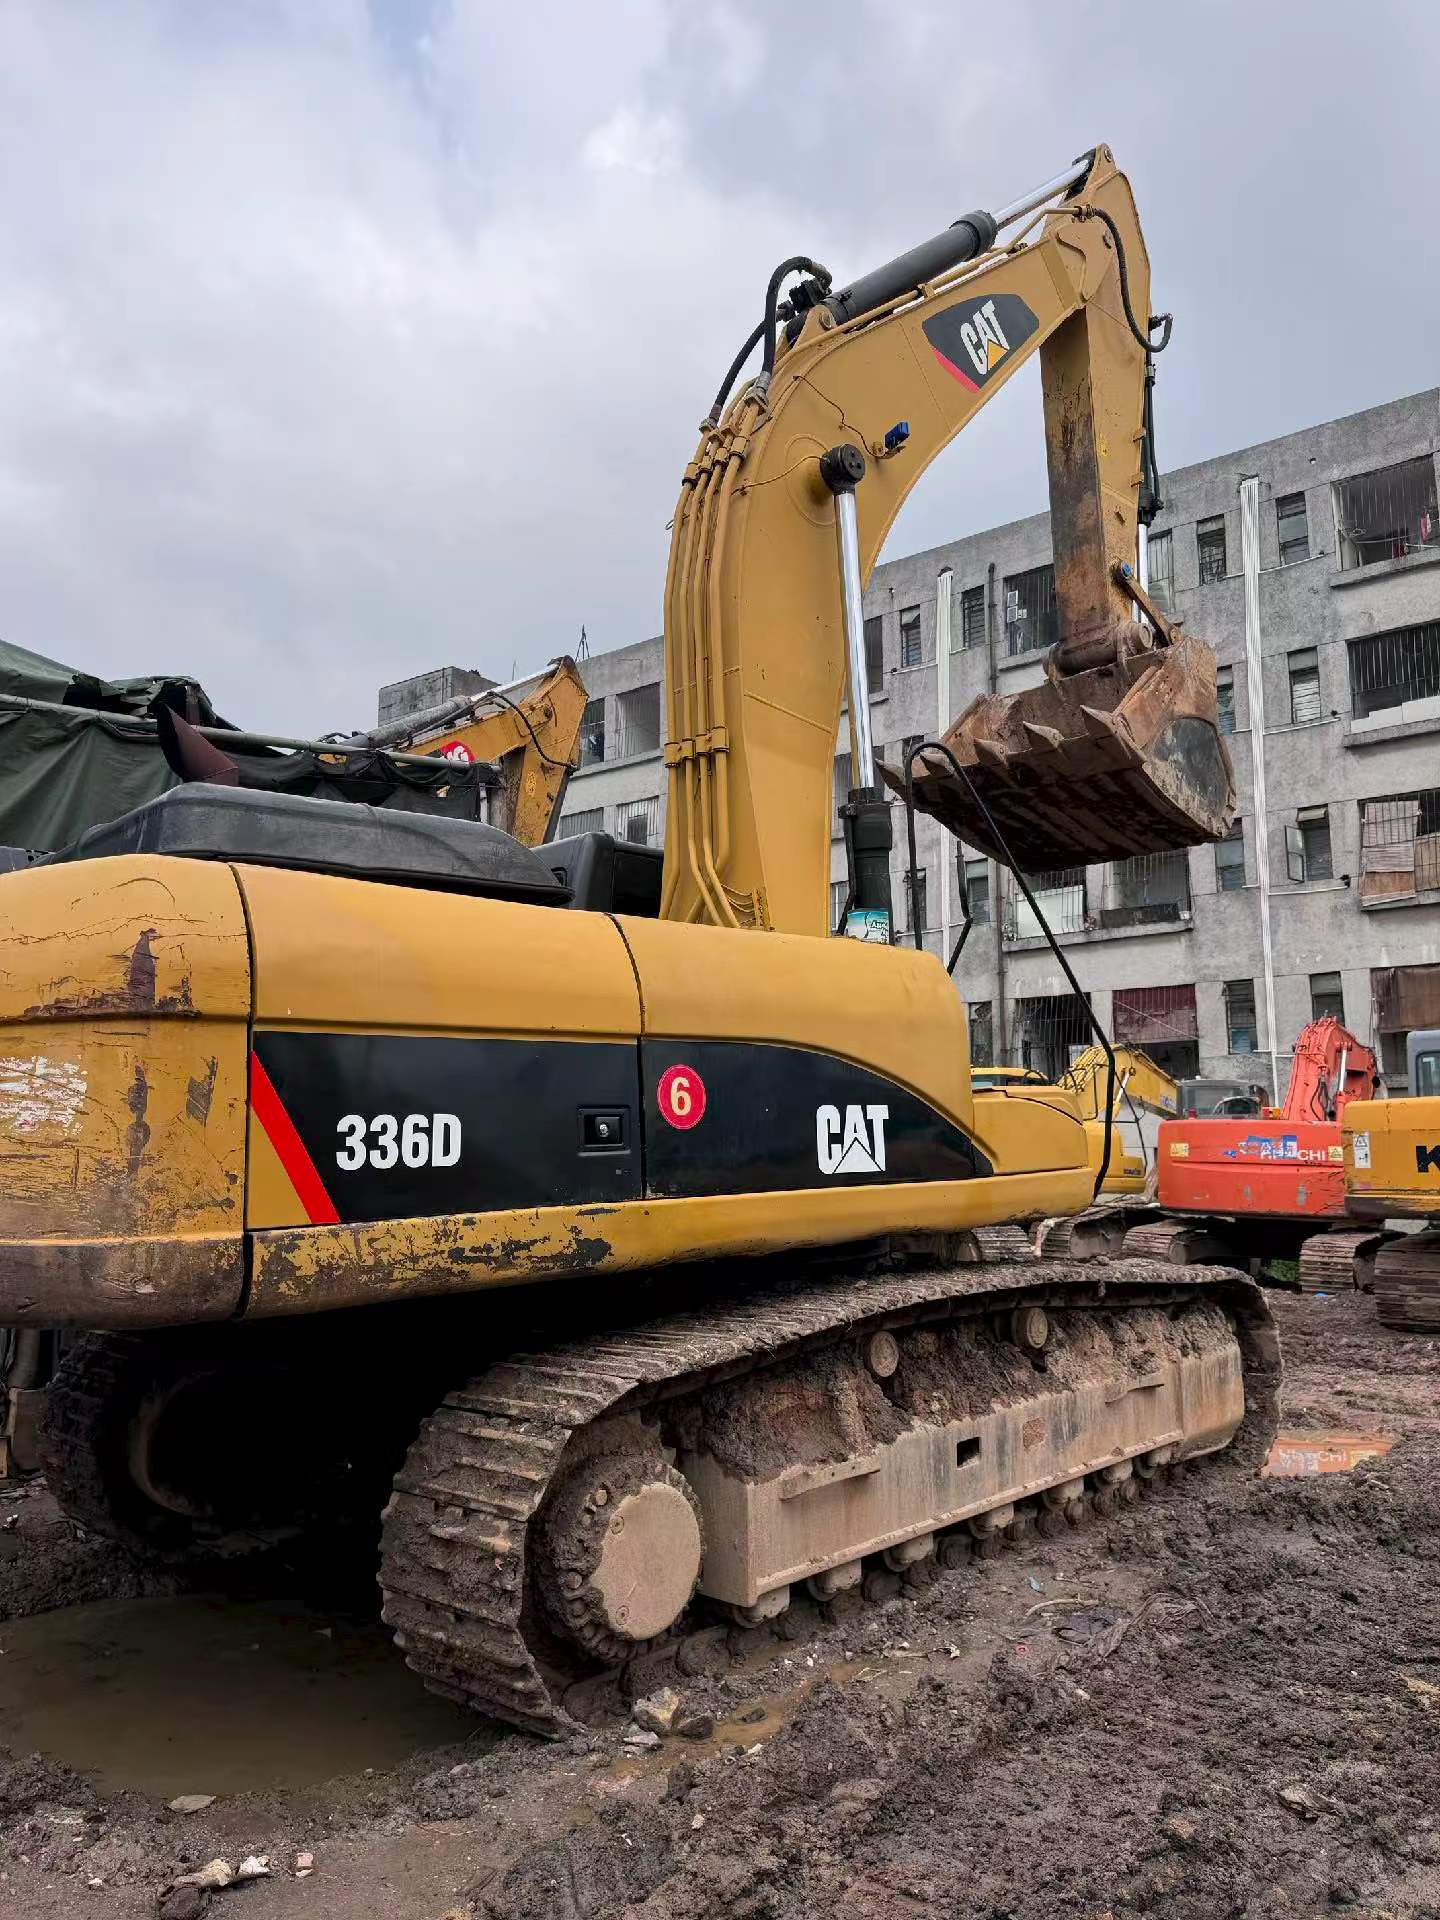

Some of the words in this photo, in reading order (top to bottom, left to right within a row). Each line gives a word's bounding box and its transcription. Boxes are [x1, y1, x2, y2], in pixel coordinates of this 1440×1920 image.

[960, 299, 1010, 375] CAT
[669, 1076, 692, 1116] 6
[336, 1113, 462, 1171] 336D
[816, 1104, 890, 1175] CAT
